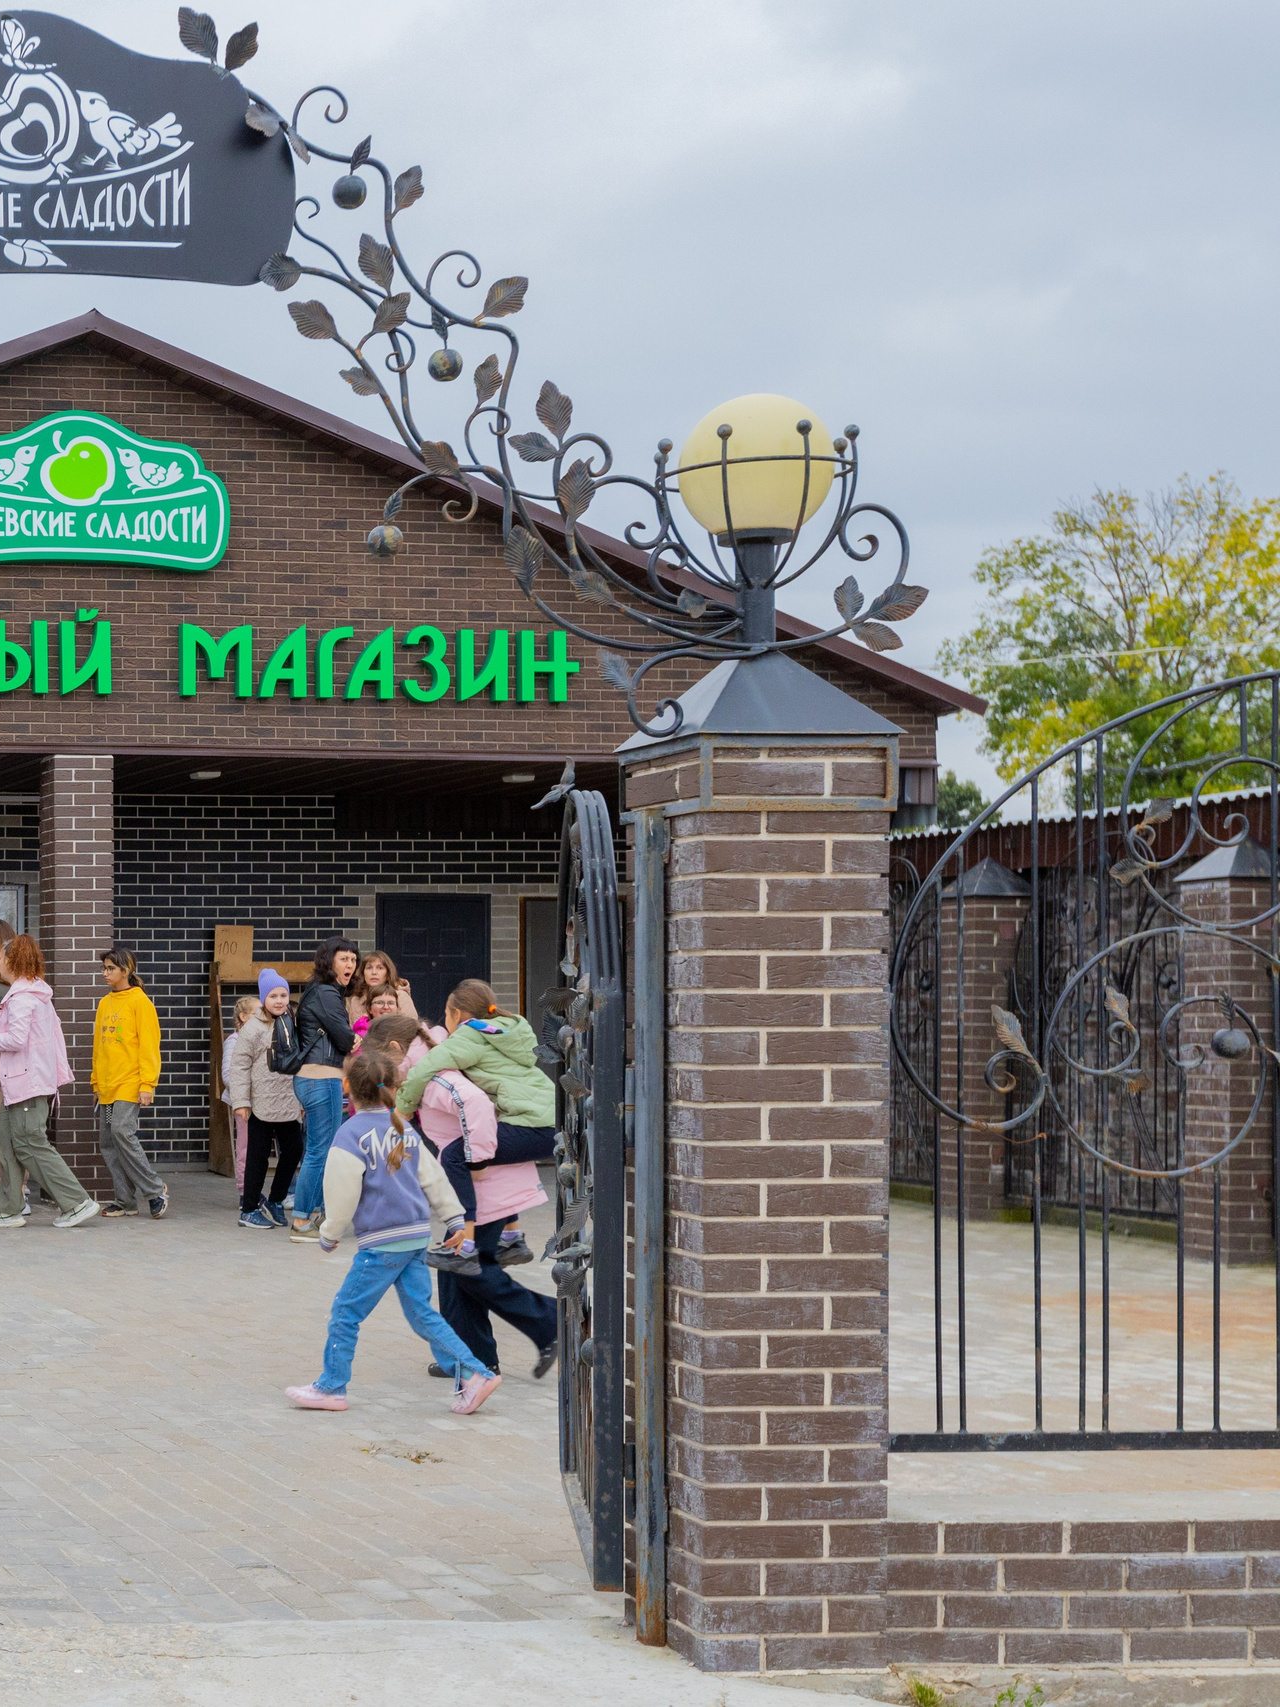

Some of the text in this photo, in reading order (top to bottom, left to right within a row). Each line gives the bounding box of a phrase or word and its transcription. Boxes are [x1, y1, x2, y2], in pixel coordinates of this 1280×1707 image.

[33, 162, 190, 232] СЛАДОСТИ
[85, 504, 207, 544] СЛАДОСТИ
[178, 623, 580, 703] МАГАЗИН
[218, 941, 238, 955] 100
